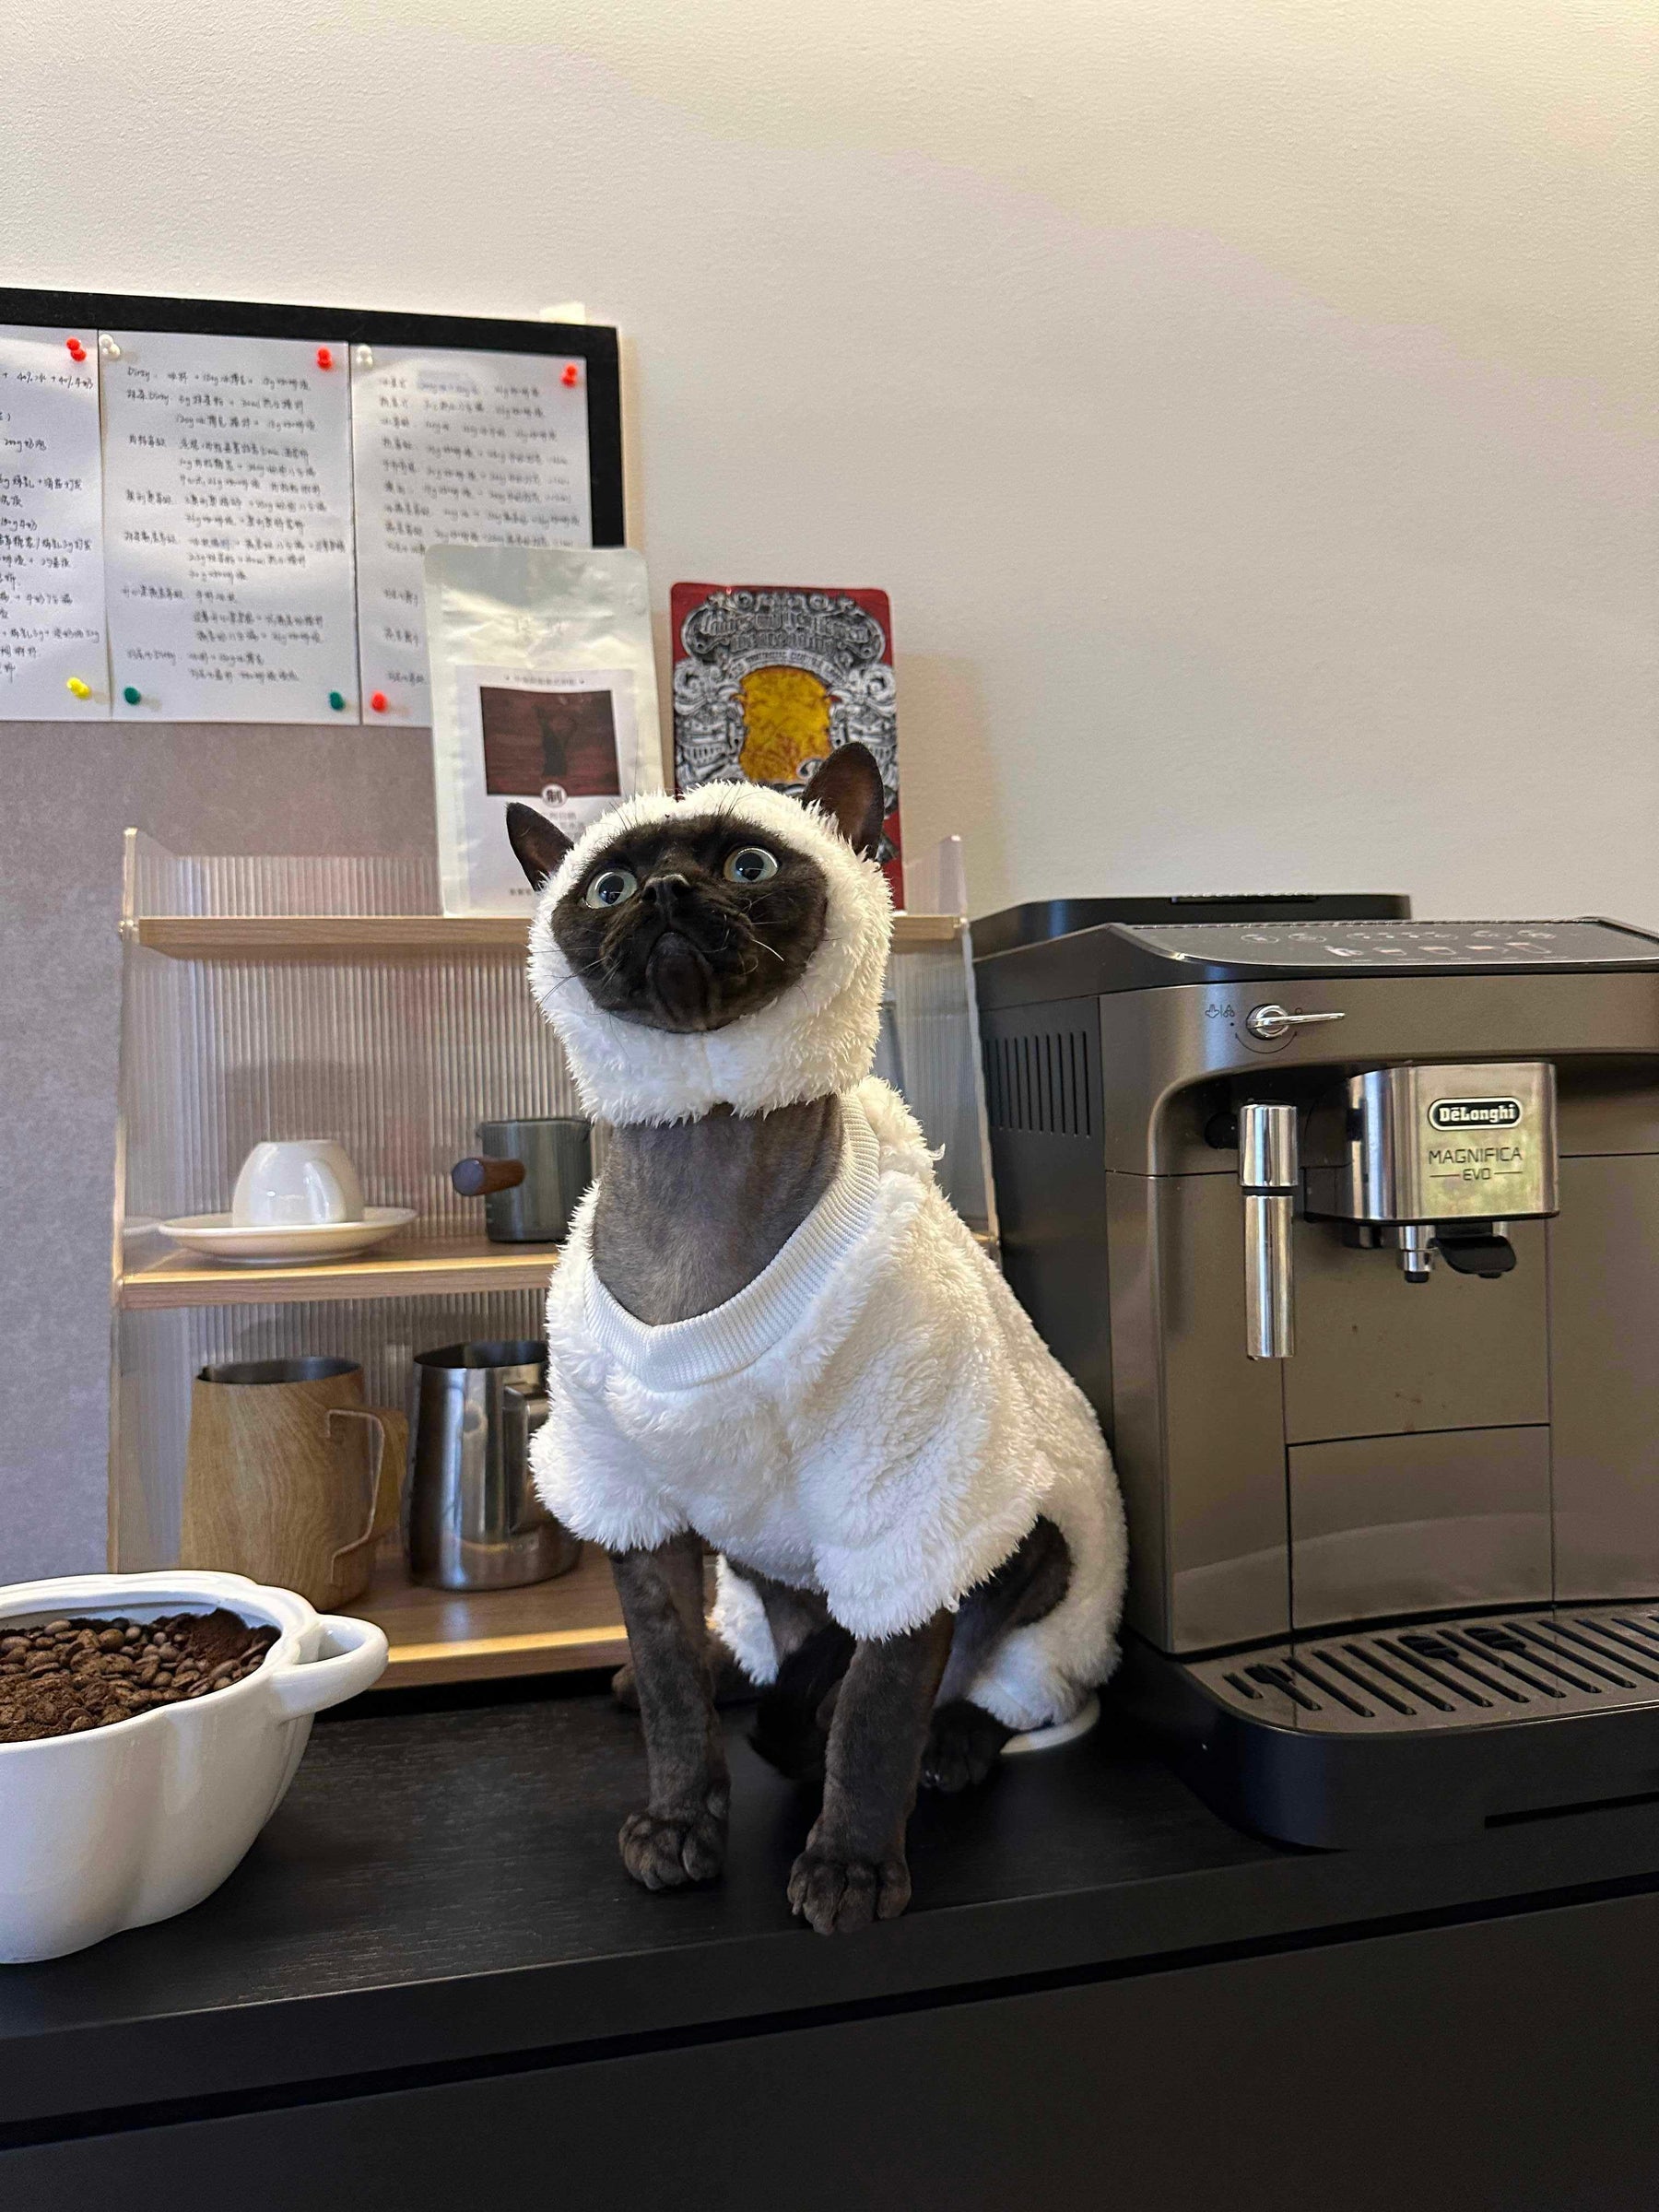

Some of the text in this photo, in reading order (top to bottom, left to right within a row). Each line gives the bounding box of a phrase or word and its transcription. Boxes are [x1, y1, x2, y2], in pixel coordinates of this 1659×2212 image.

[547, 789, 562, 803] 制
[1429, 1147, 1523, 1164] MAGNIFICA
[1463, 1168, 1491, 1181] EVO
